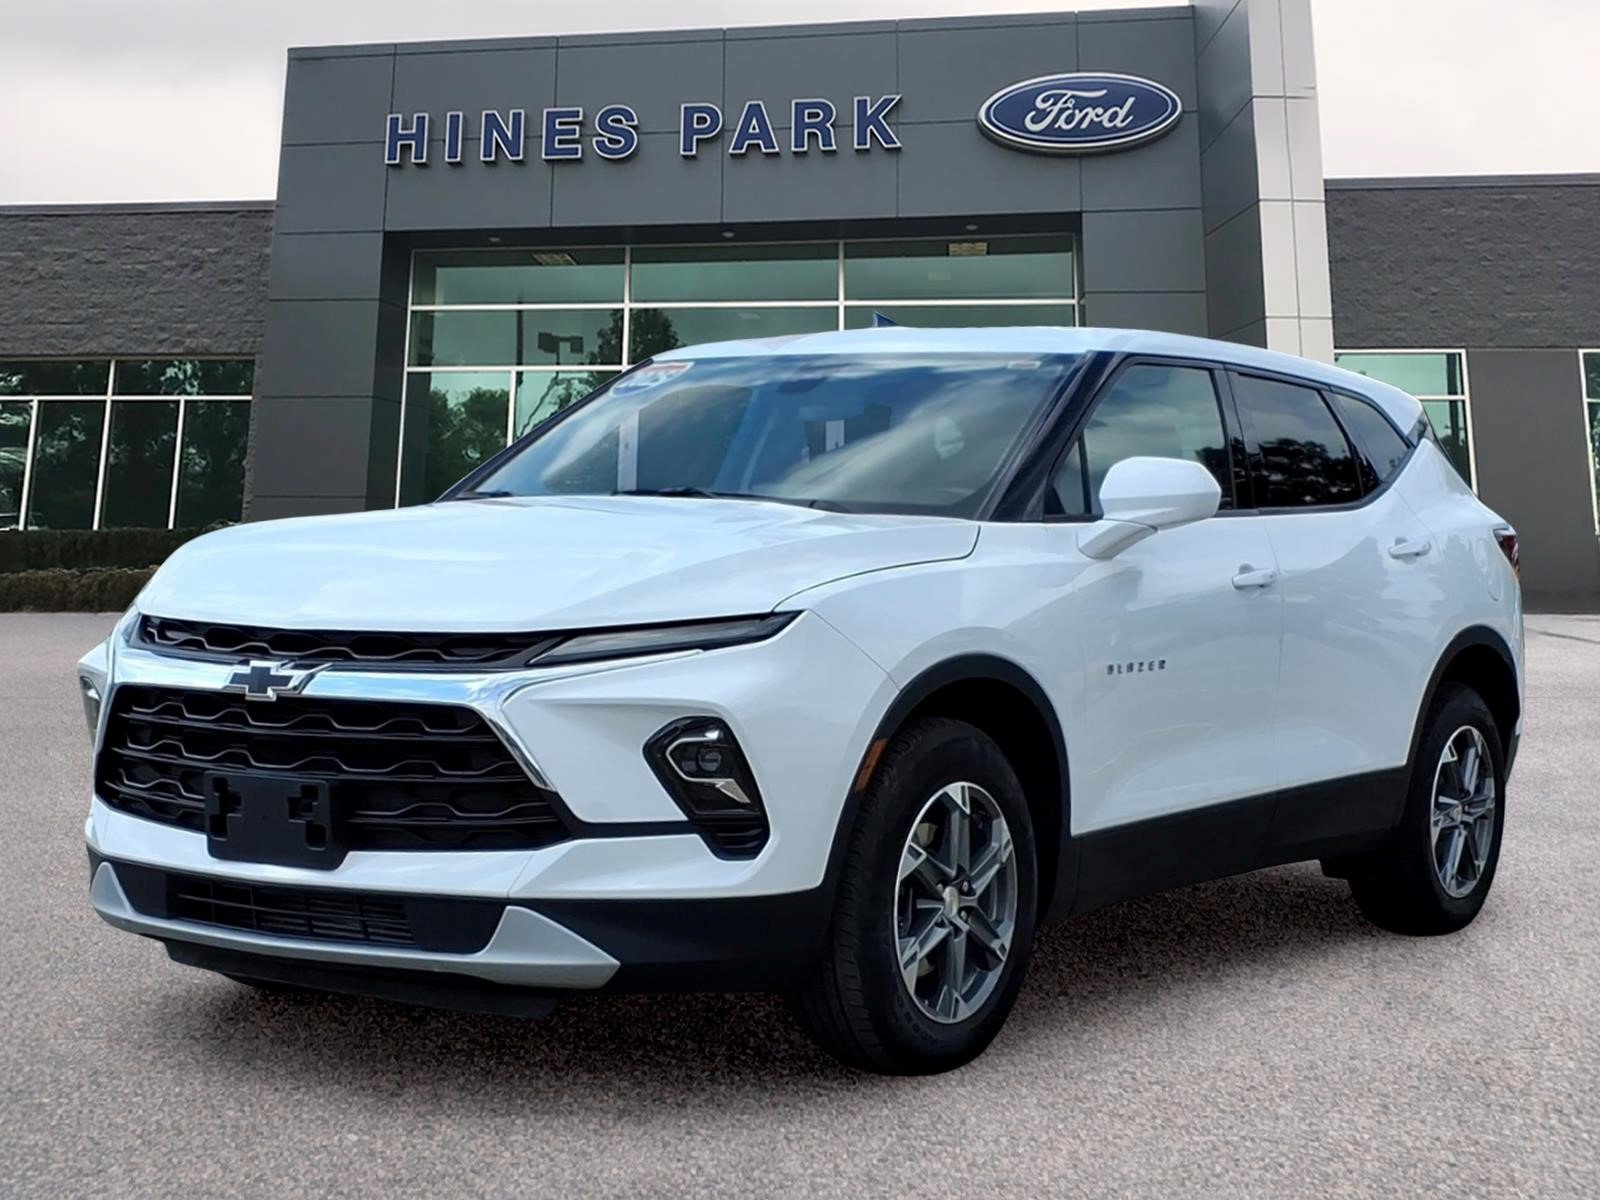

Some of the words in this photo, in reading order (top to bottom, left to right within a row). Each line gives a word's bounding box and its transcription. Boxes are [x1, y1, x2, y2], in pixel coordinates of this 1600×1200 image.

[385, 104, 639, 164] HINES
[679, 95, 903, 157] PARK
[1024, 89, 1136, 132] Ford
[1106, 659, 1166, 676] BLAZER
